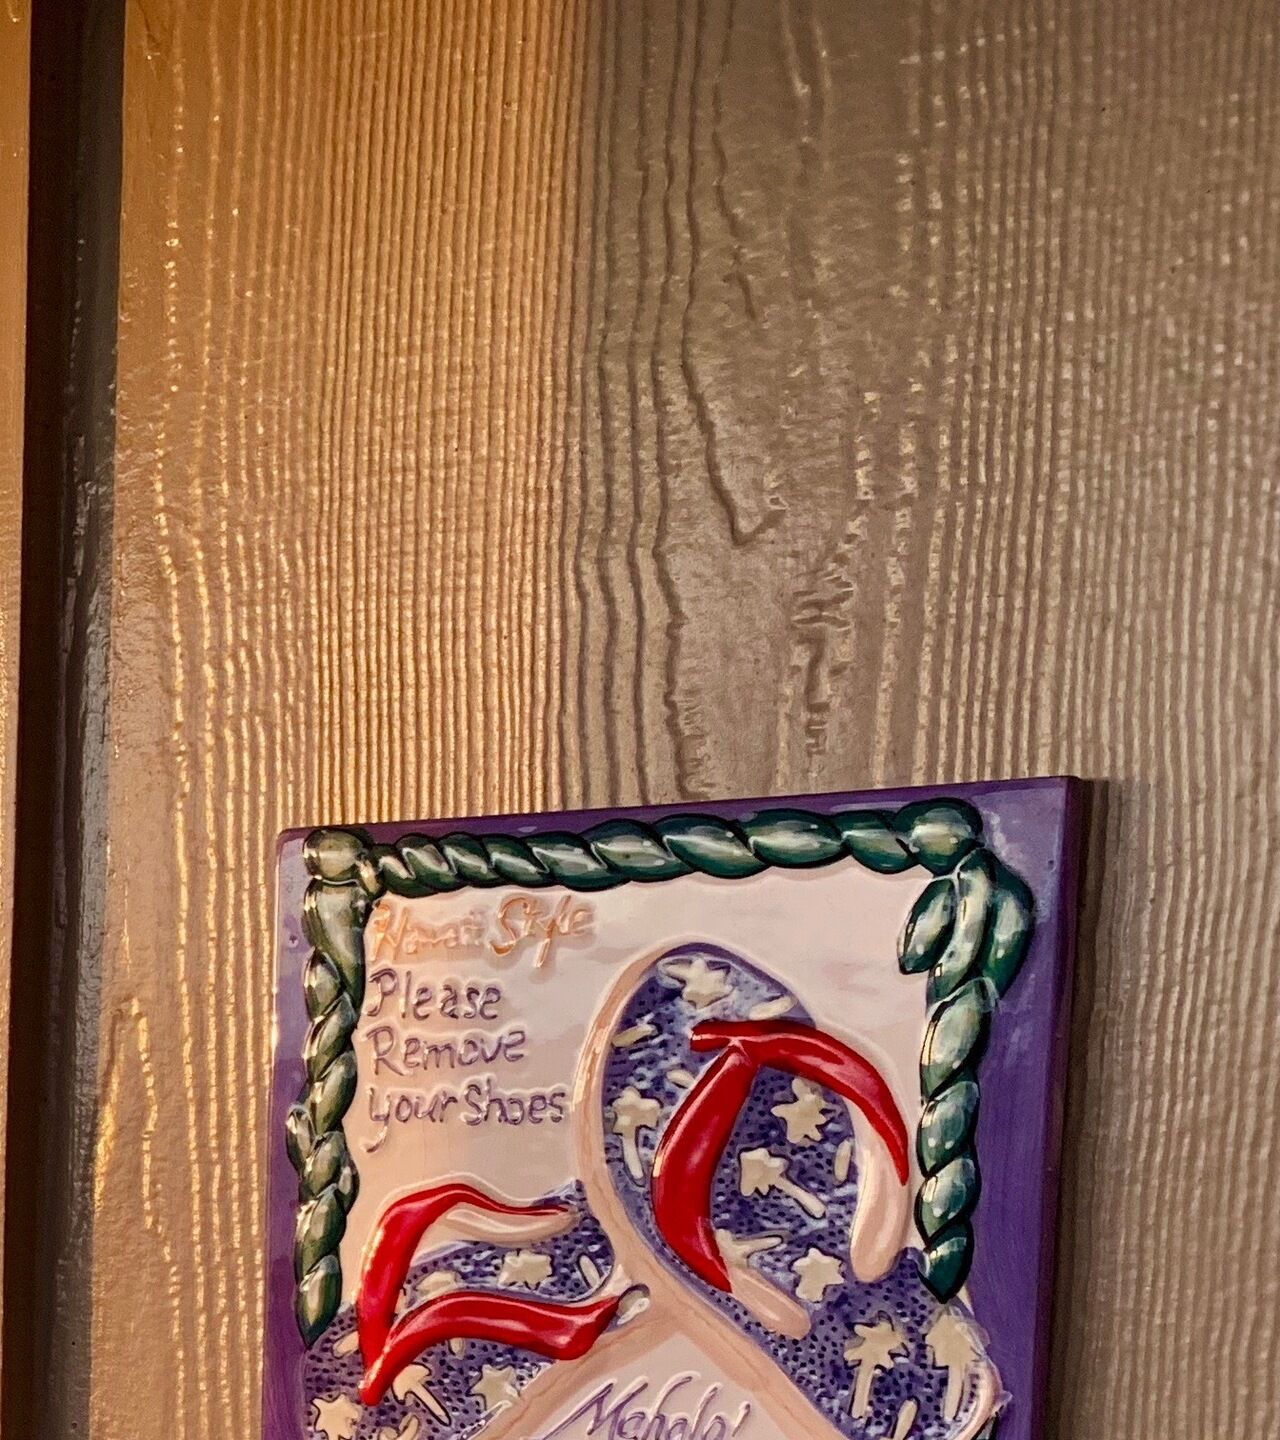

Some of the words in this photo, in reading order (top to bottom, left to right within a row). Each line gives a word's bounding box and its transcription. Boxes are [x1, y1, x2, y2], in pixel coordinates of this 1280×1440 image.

[489, 894, 594, 968] Style
[365, 967, 502, 1021] Please
[366, 1025, 527, 1076] Remove
[460, 1077, 566, 1127] Shoes
